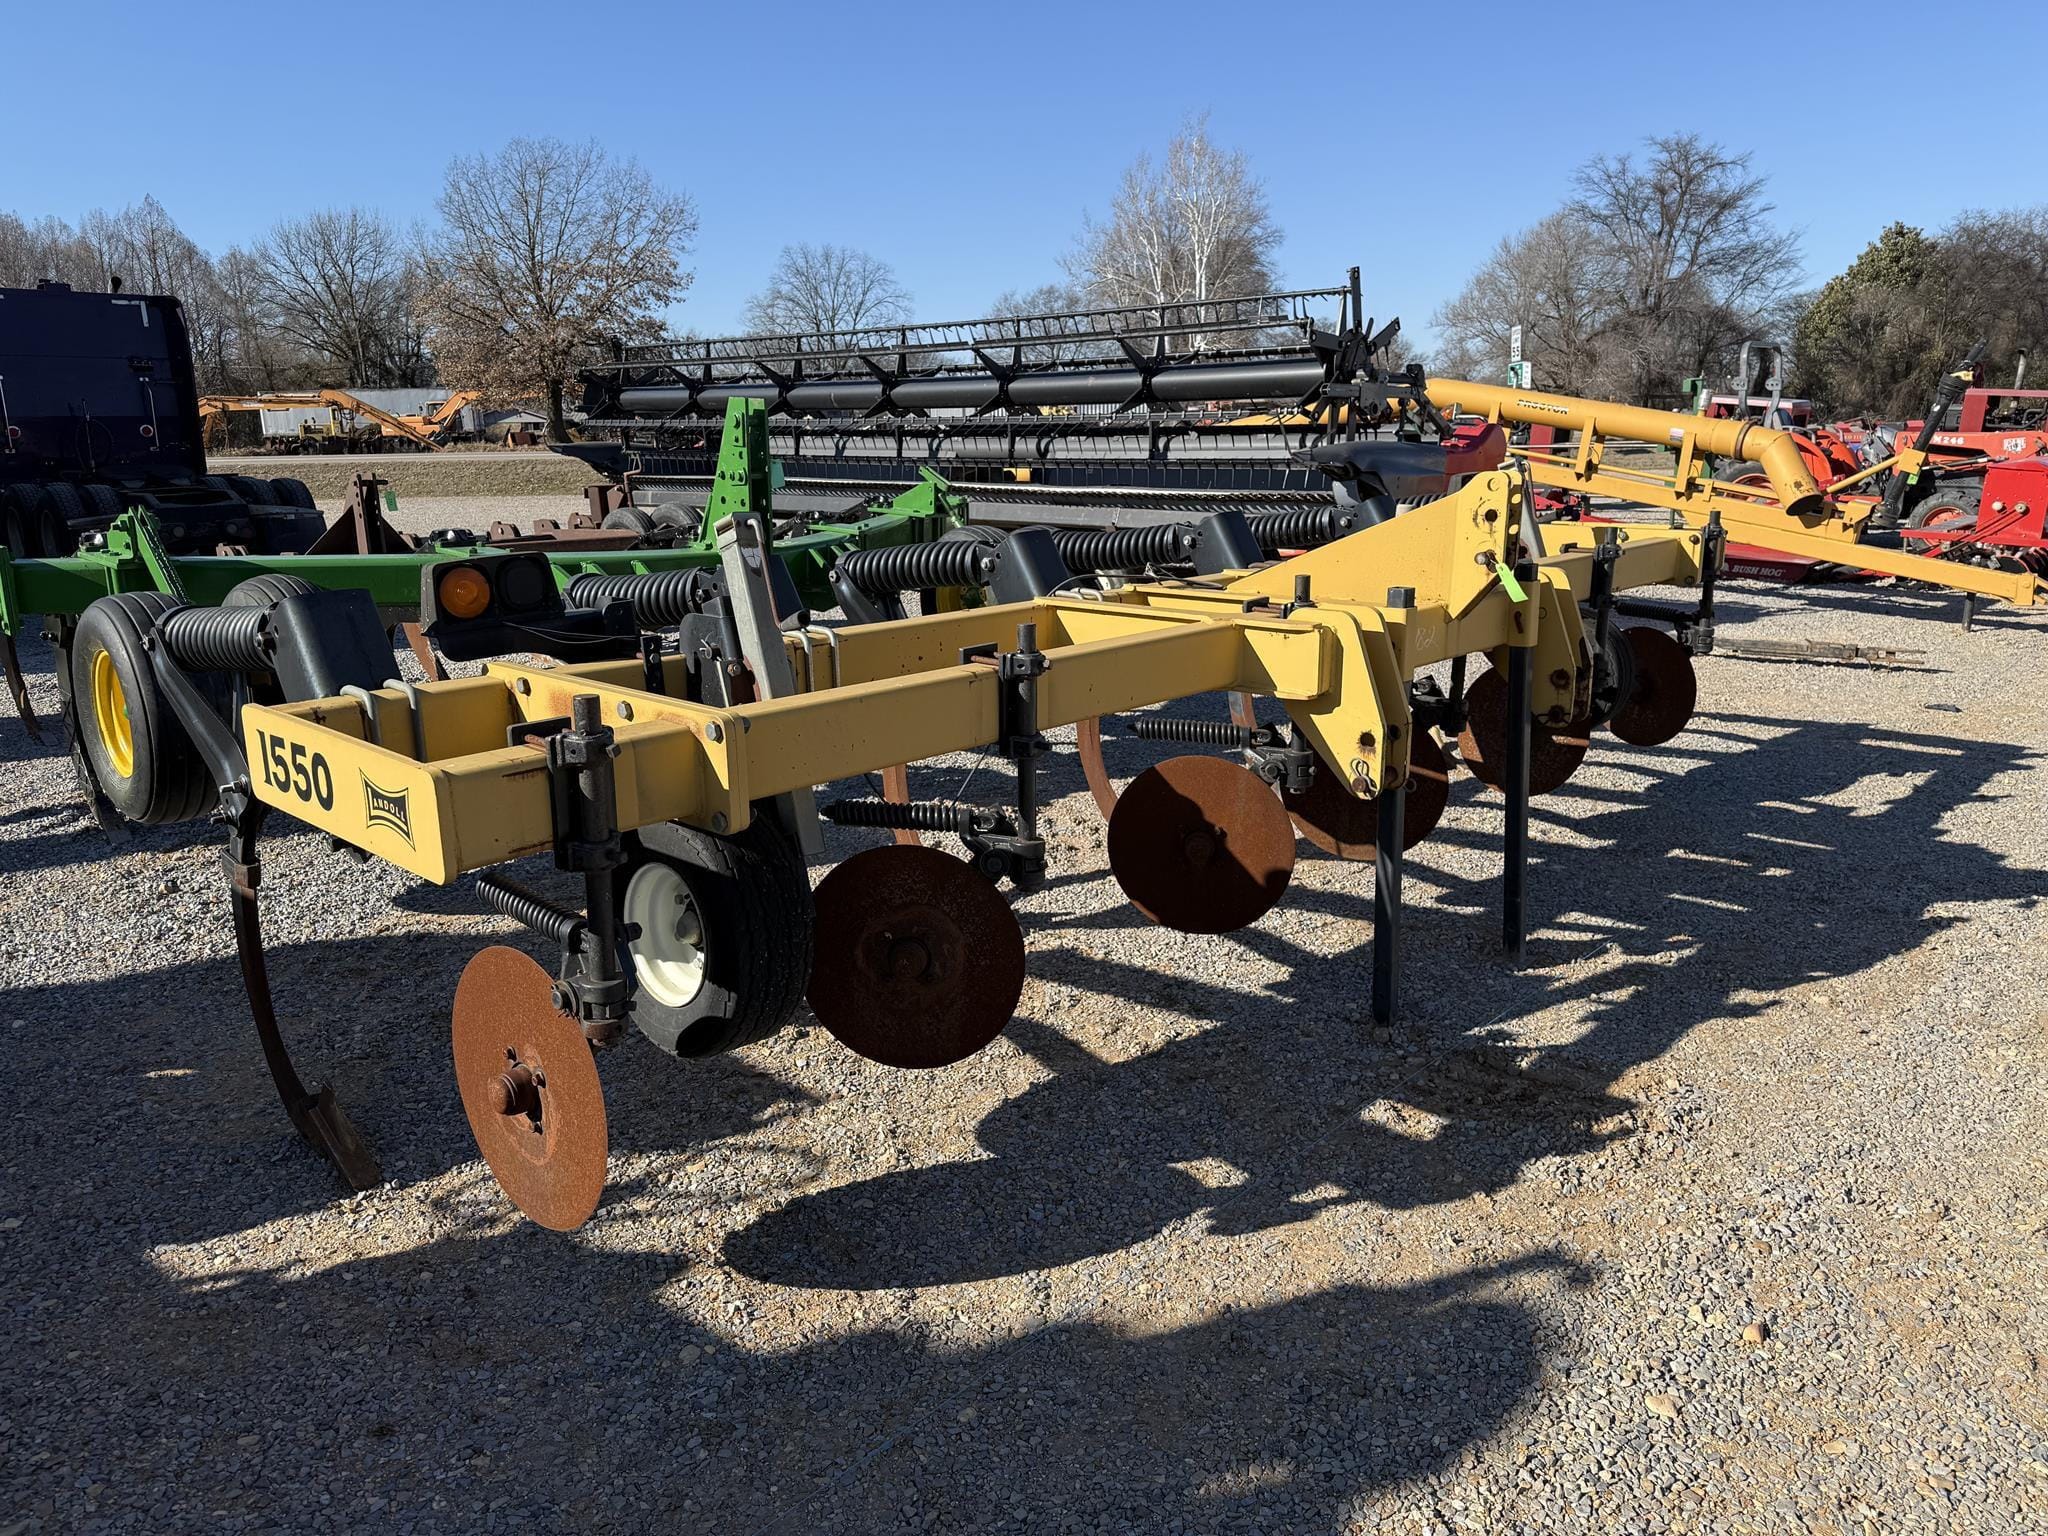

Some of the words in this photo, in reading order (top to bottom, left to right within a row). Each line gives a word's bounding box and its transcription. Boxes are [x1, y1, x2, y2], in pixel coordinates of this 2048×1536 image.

[1732, 565, 1760, 575] BUSH
[1760, 567, 1782, 577] HOG
[256, 728, 334, 811] 1550
[367, 787, 406, 828] LANDOLL
